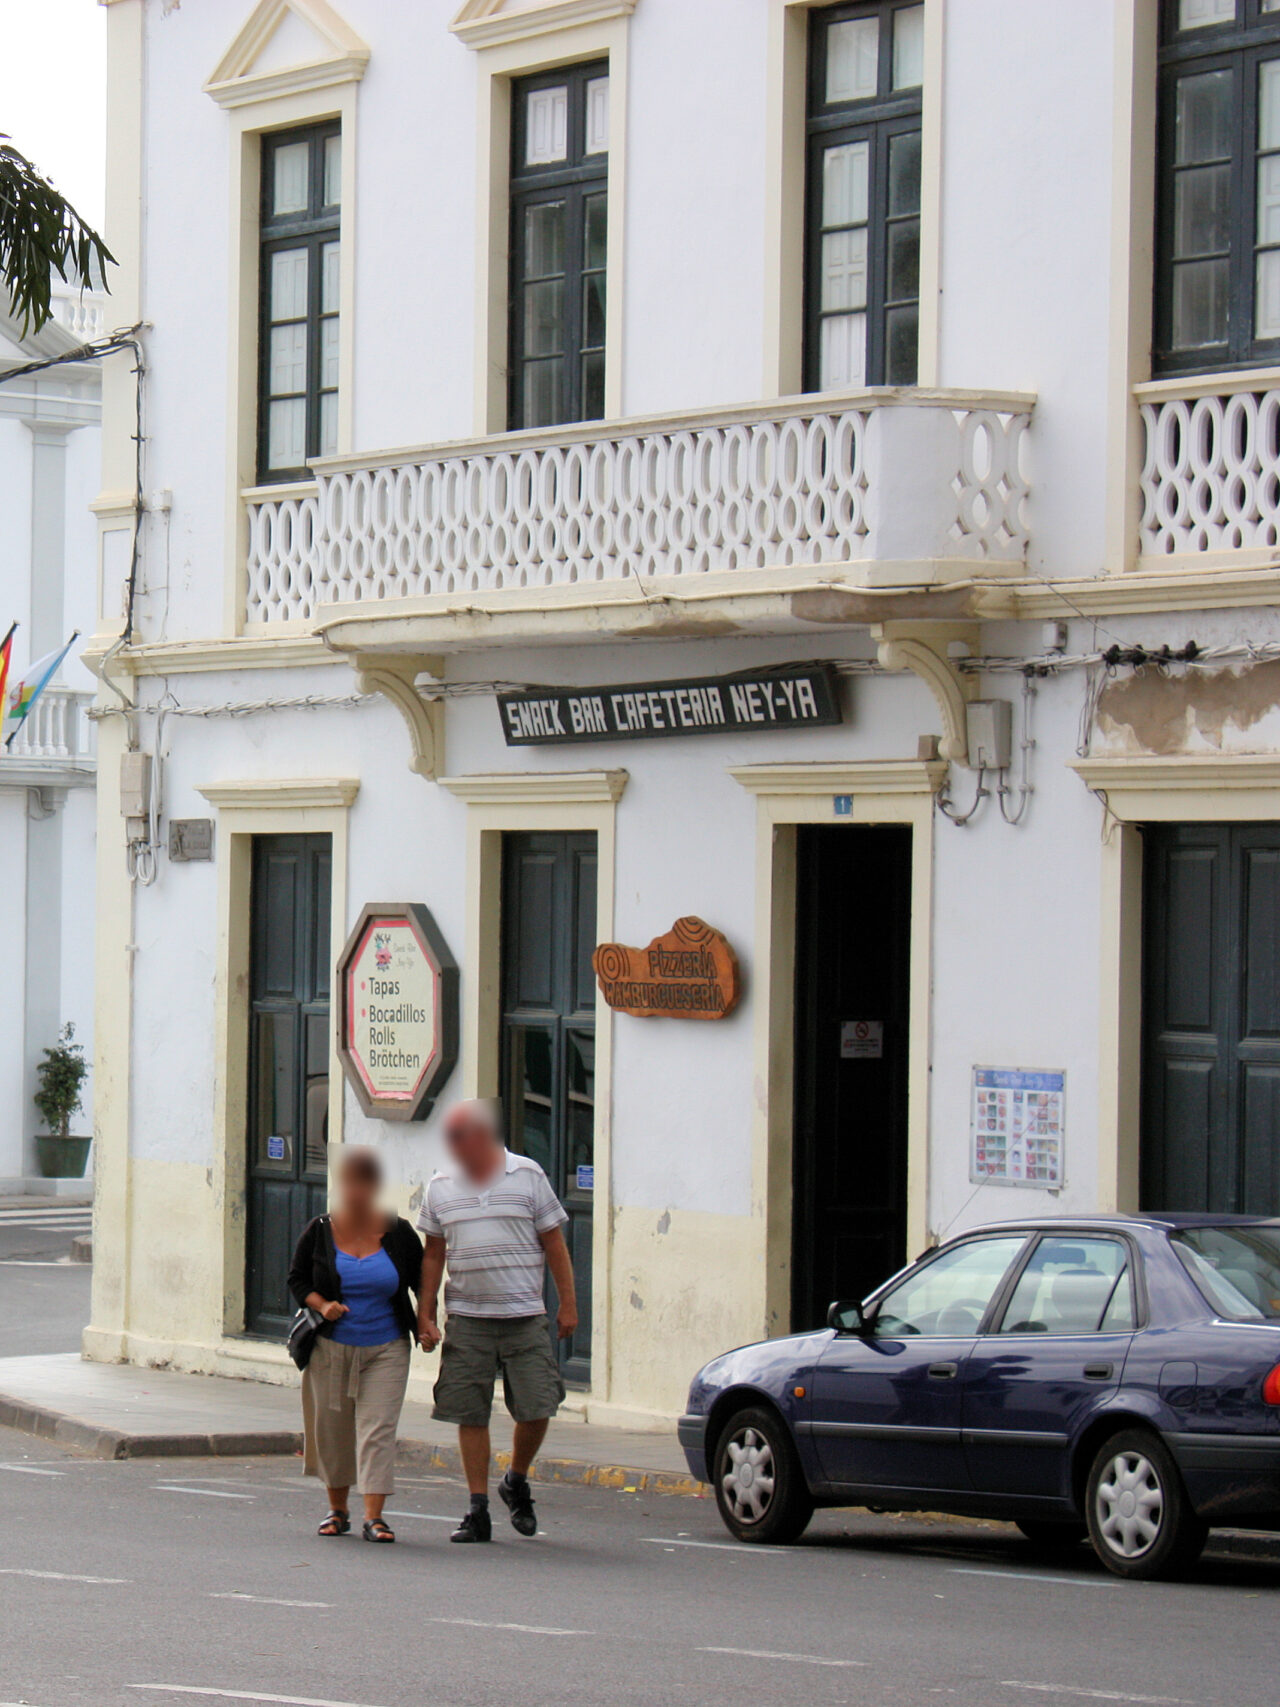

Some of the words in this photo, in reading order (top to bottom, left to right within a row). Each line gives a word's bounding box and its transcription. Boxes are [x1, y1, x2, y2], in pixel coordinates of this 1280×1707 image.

[506, 700, 566, 738] SNACK
[569, 697, 608, 734] BAR
[611, 687, 725, 731] CAFETERIA
[729, 679, 818, 723] NEY-YA
[369, 977, 400, 999] Tapas
[369, 1005, 426, 1024] Bocadillos
[370, 1027, 396, 1046] Rolls
[370, 1049, 420, 1069] Brötchen
